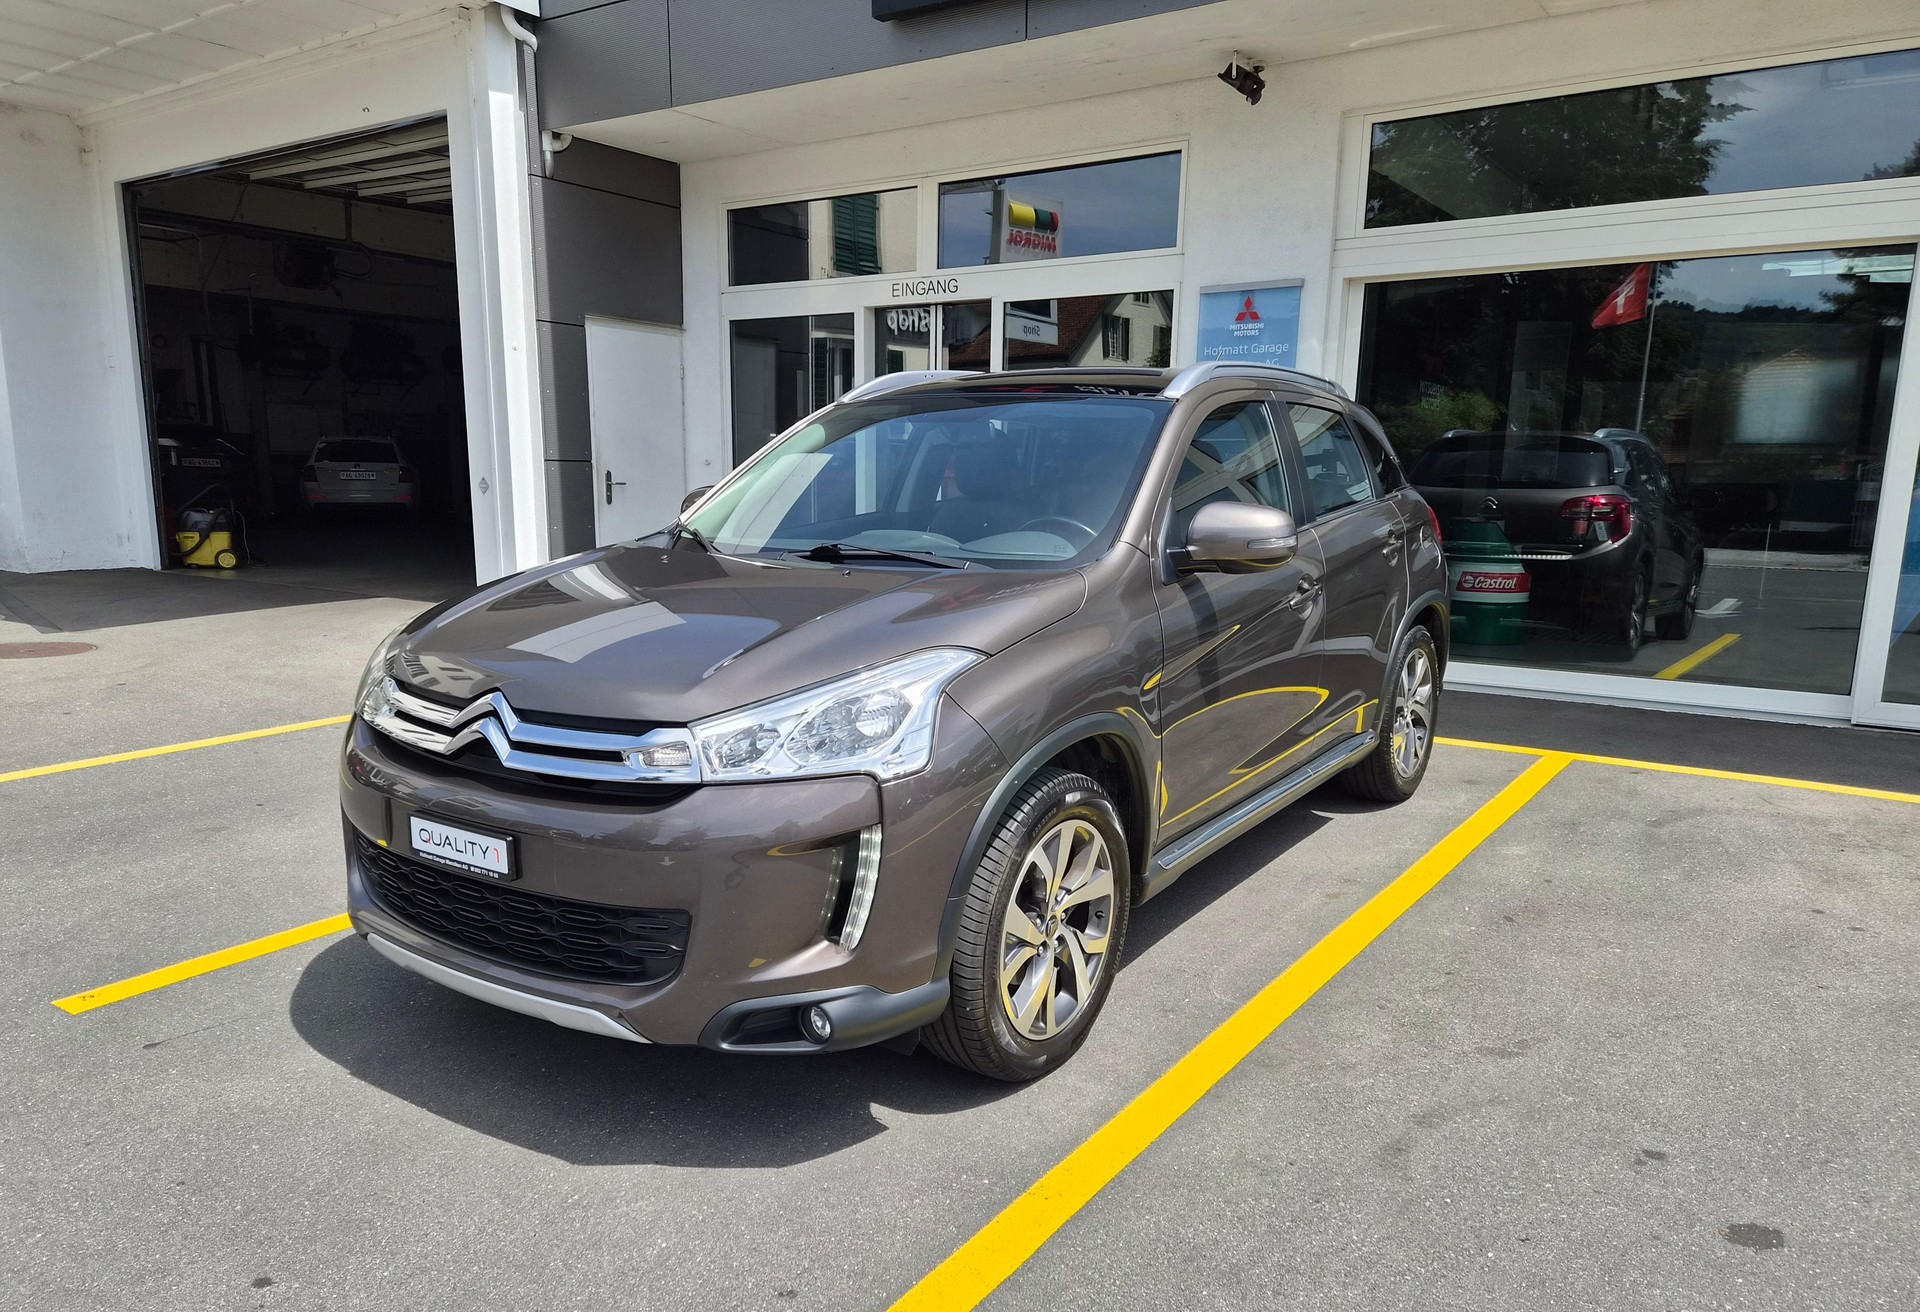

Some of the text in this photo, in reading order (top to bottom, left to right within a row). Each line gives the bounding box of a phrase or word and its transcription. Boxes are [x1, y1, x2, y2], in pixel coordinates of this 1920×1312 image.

[891, 278, 959, 298] EINGANG
[1230, 322, 1264, 330] MITSUBISHI
[1204, 342, 1289, 356] Hofmatt Garage
[1474, 576, 1518, 589] Castrol
